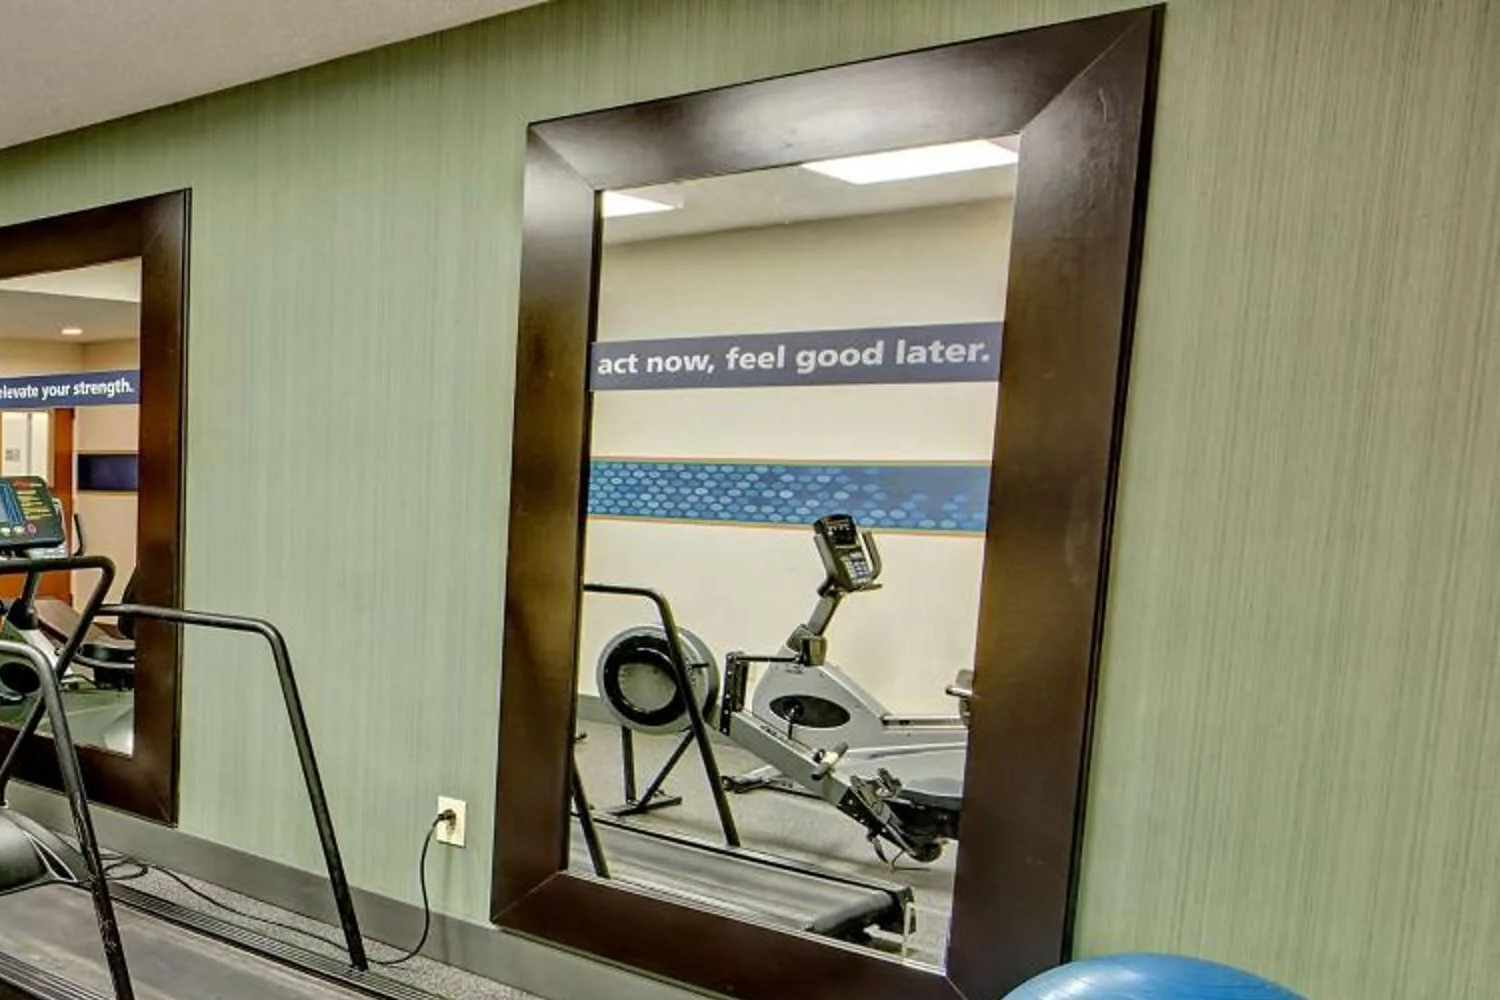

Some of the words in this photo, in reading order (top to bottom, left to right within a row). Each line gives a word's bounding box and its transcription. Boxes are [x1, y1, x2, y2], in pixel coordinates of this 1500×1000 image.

[597, 350, 639, 375] act
[646, 350, 715, 375] now,
[725, 344, 786, 372] feel
[795, 339, 884, 375] good
[895, 338, 991, 366] later.
[41, 383, 71, 401] your
[73, 376, 135, 399] strength.
